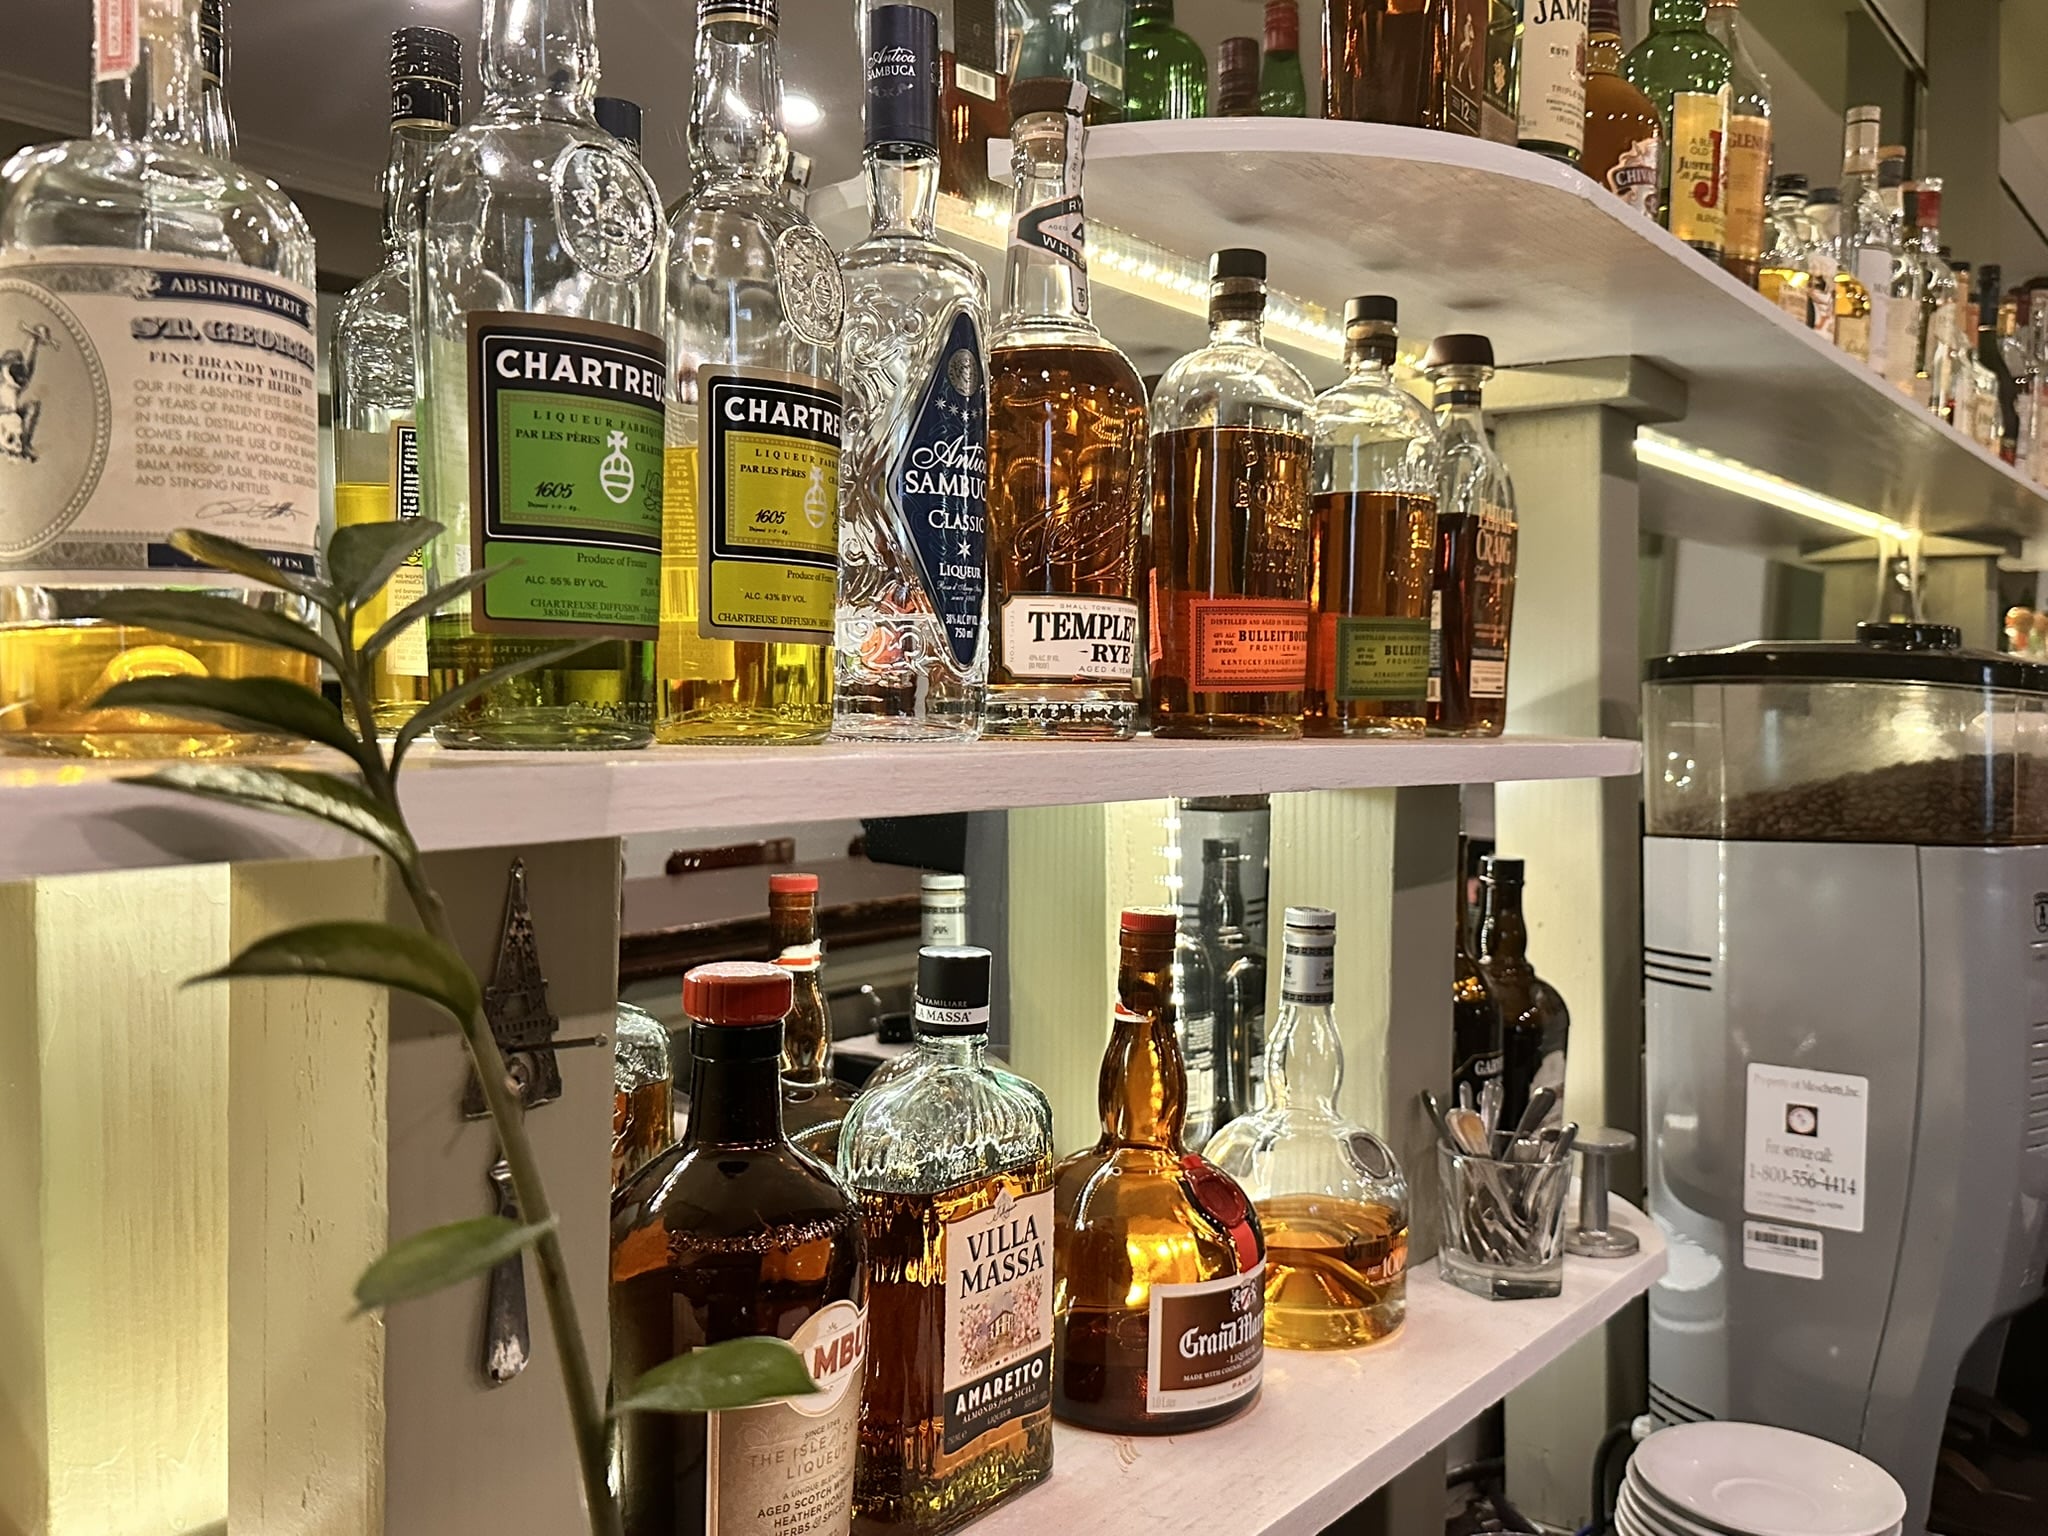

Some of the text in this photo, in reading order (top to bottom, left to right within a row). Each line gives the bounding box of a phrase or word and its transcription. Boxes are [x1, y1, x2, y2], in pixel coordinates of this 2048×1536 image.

[867, 45, 917, 69] Antica
[867, 65, 916, 80] SAMBUCA
[1461, 99, 1470, 122] 12
[1048, 223, 1068, 231] AGED
[170, 277, 302, 317] ABSINTHE VERTE
[149, 351, 313, 390] FINE BRANDY WITH THE
[182, 368, 303, 397] CHOICEST HERBS
[133, 379, 164, 393] OUR
[168, 382, 195, 395] FINE
[200, 385, 252, 403] ABSINTHE
[256, 393, 282, 408] VERTE
[134, 396, 262, 419] OF YEARS OF PATIENT
[134, 411, 150, 422] IN
[154, 413, 201, 426] HERBAL
[533, 410, 613, 427] LIQUEUR
[135, 427, 281, 451] COMES FROM THE USE OF
[515, 429, 601, 445] PAR LES PÈRES
[135, 442, 167, 455] STAR
[755, 448, 815, 464] LIQUEUR
[740, 464, 807, 479] PAR LES PÈRES
[134, 475, 166, 489] AND
[169, 477, 229, 493] STINGING
[534, 481, 576, 499] 1605
[755, 509, 787, 524] 1605
[928, 509, 985, 534] CLASSIC
[577, 553, 614, 566] Produce
[616, 554, 626, 567] of
[787, 569, 814, 581] Produce
[939, 562, 982, 580] LIQUEUR
[574, 579, 587, 588] BY
[530, 598, 640, 613] CHARTREUSE DIFFUSION
[764, 593, 780, 601] 43%
[781, 594, 792, 602] BY
[718, 612, 778, 625] CHARTREUSE
[780, 616, 817, 627] DIFFUSION
[955, 627, 966, 638] 750
[1238, 630, 1286, 642] BULLEIT
[1090, 643, 1131, 665] RYE
[1249, 644, 1290, 652] FRONTIER
[1078, 665, 1107, 673] AGED
[925, 998, 967, 1008] FAMILIARE
[926, 1009, 970, 1023] MASSA
[1783, 1144, 1813, 1160] service
[967, 1213, 1039, 1262] VILLA
[960, 1242, 1044, 1299] MASSA
[1179, 1322, 1238, 1359] Grand
[1183, 1373, 1203, 1382] MADE
[1204, 1369, 1221, 1379] WITH
[955, 1358, 1043, 1416] AMARETTO
[962, 1401, 998, 1424] ALMONDS
[997, 1396, 1013, 1410] from
[1014, 1382, 1037, 1399] SICILY
[805, 1425, 825, 1440] SINCE
[750, 1435, 826, 1467] THE ISLE
[787, 1441, 848, 1480] LIQUEUR
[791, 1482, 819, 1498] UNIQUE
[757, 1487, 832, 1519] AGED SCOTCH
[773, 1503, 822, 1529] HEATHER
[775, 1499, 846, 1536] HERBS & SPICES
